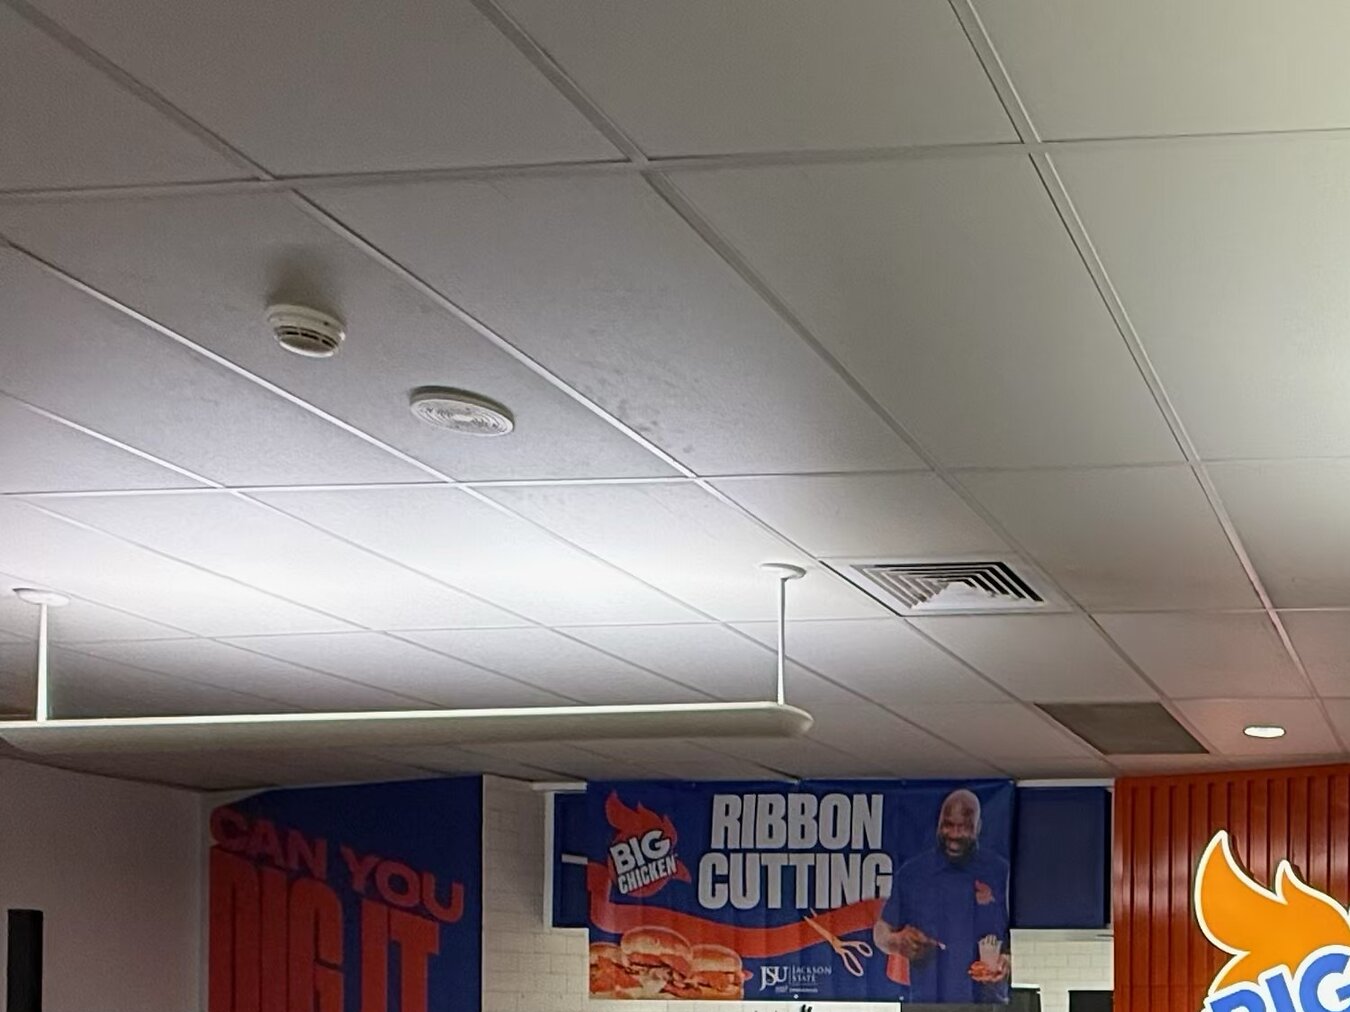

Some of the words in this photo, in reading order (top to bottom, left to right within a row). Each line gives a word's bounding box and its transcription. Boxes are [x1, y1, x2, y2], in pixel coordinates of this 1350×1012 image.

[710, 793, 884, 850] RIBBON
[211, 805, 327, 880] CAN
[339, 844, 464, 923] YOU
[609, 830, 671, 874] BIG
[617, 854, 677, 894] CHICKEN
[698, 852, 893, 910] CUTTING
[760, 966, 789, 991] JSU
[792, 965, 832, 975] JACKSON
